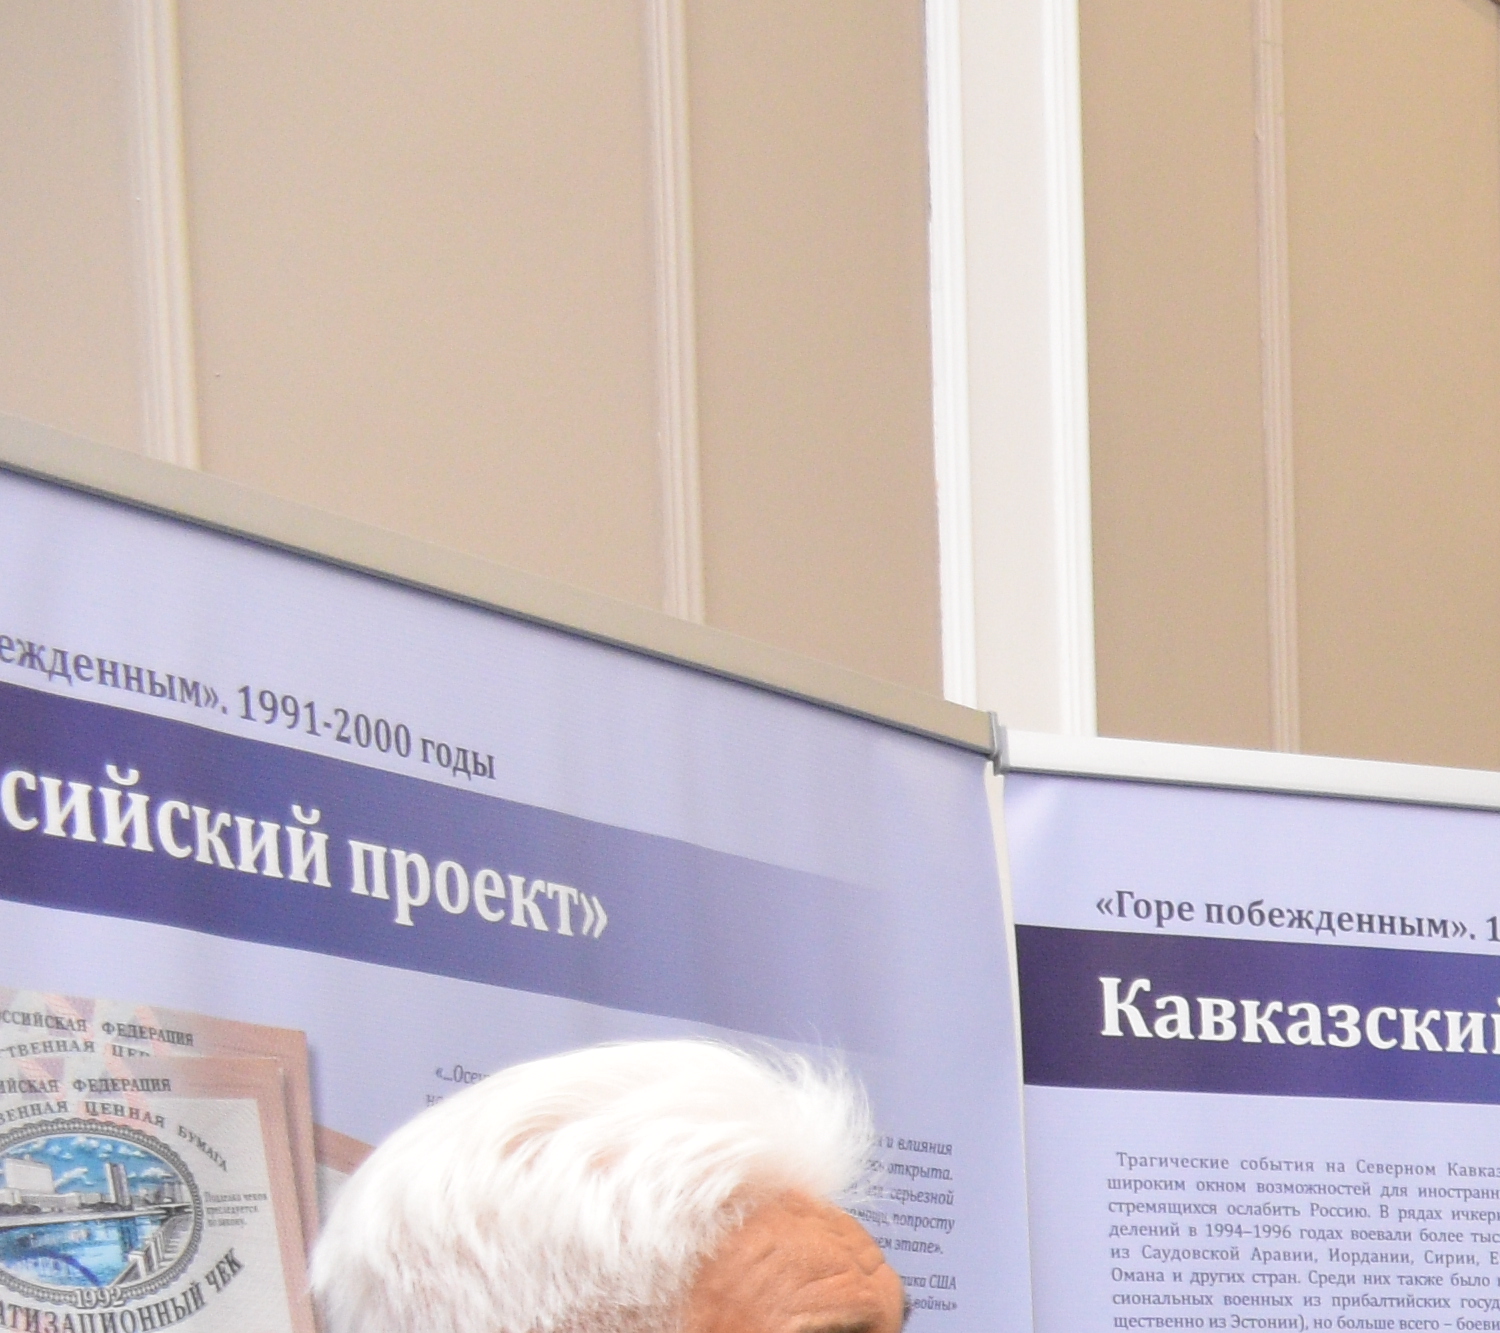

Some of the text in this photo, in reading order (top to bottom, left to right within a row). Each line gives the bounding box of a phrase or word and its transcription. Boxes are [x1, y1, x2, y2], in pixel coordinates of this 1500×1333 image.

[237, 684, 412, 759] 1991-2000
[420, 736, 496, 782] годы
[347, 838, 608, 940] проект»
[1095, 889, 1195, 929] «Горе
[1204, 898, 1476, 941] побежденным».
[84, 1102, 166, 1129] ЦЕННАЯ
[178, 1126, 228, 1172] БУМАГА
[897, 1137, 953, 1157] влияния
[887, 1162, 953, 1182] открыта.
[1115, 1150, 1230, 1172] Трагические
[1239, 1154, 1315, 1173] события
[1325, 1160, 1346, 1174] на
[1355, 1158, 1436, 1180] Северном
[1106, 1177, 1186, 1195] широким
[1195, 1179, 1246, 1194] окном
[1255, 1180, 1372, 1197] возможностей
[1379, 1185, 1408, 1200] для
[892, 1211, 956, 1236] попросту
[894, 1238, 944, 1255] этапе».
[205, 1247, 244, 1293] ЧЕК
[928, 1273, 957, 1291] США
[75, 1287, 123, 1308] 1992
